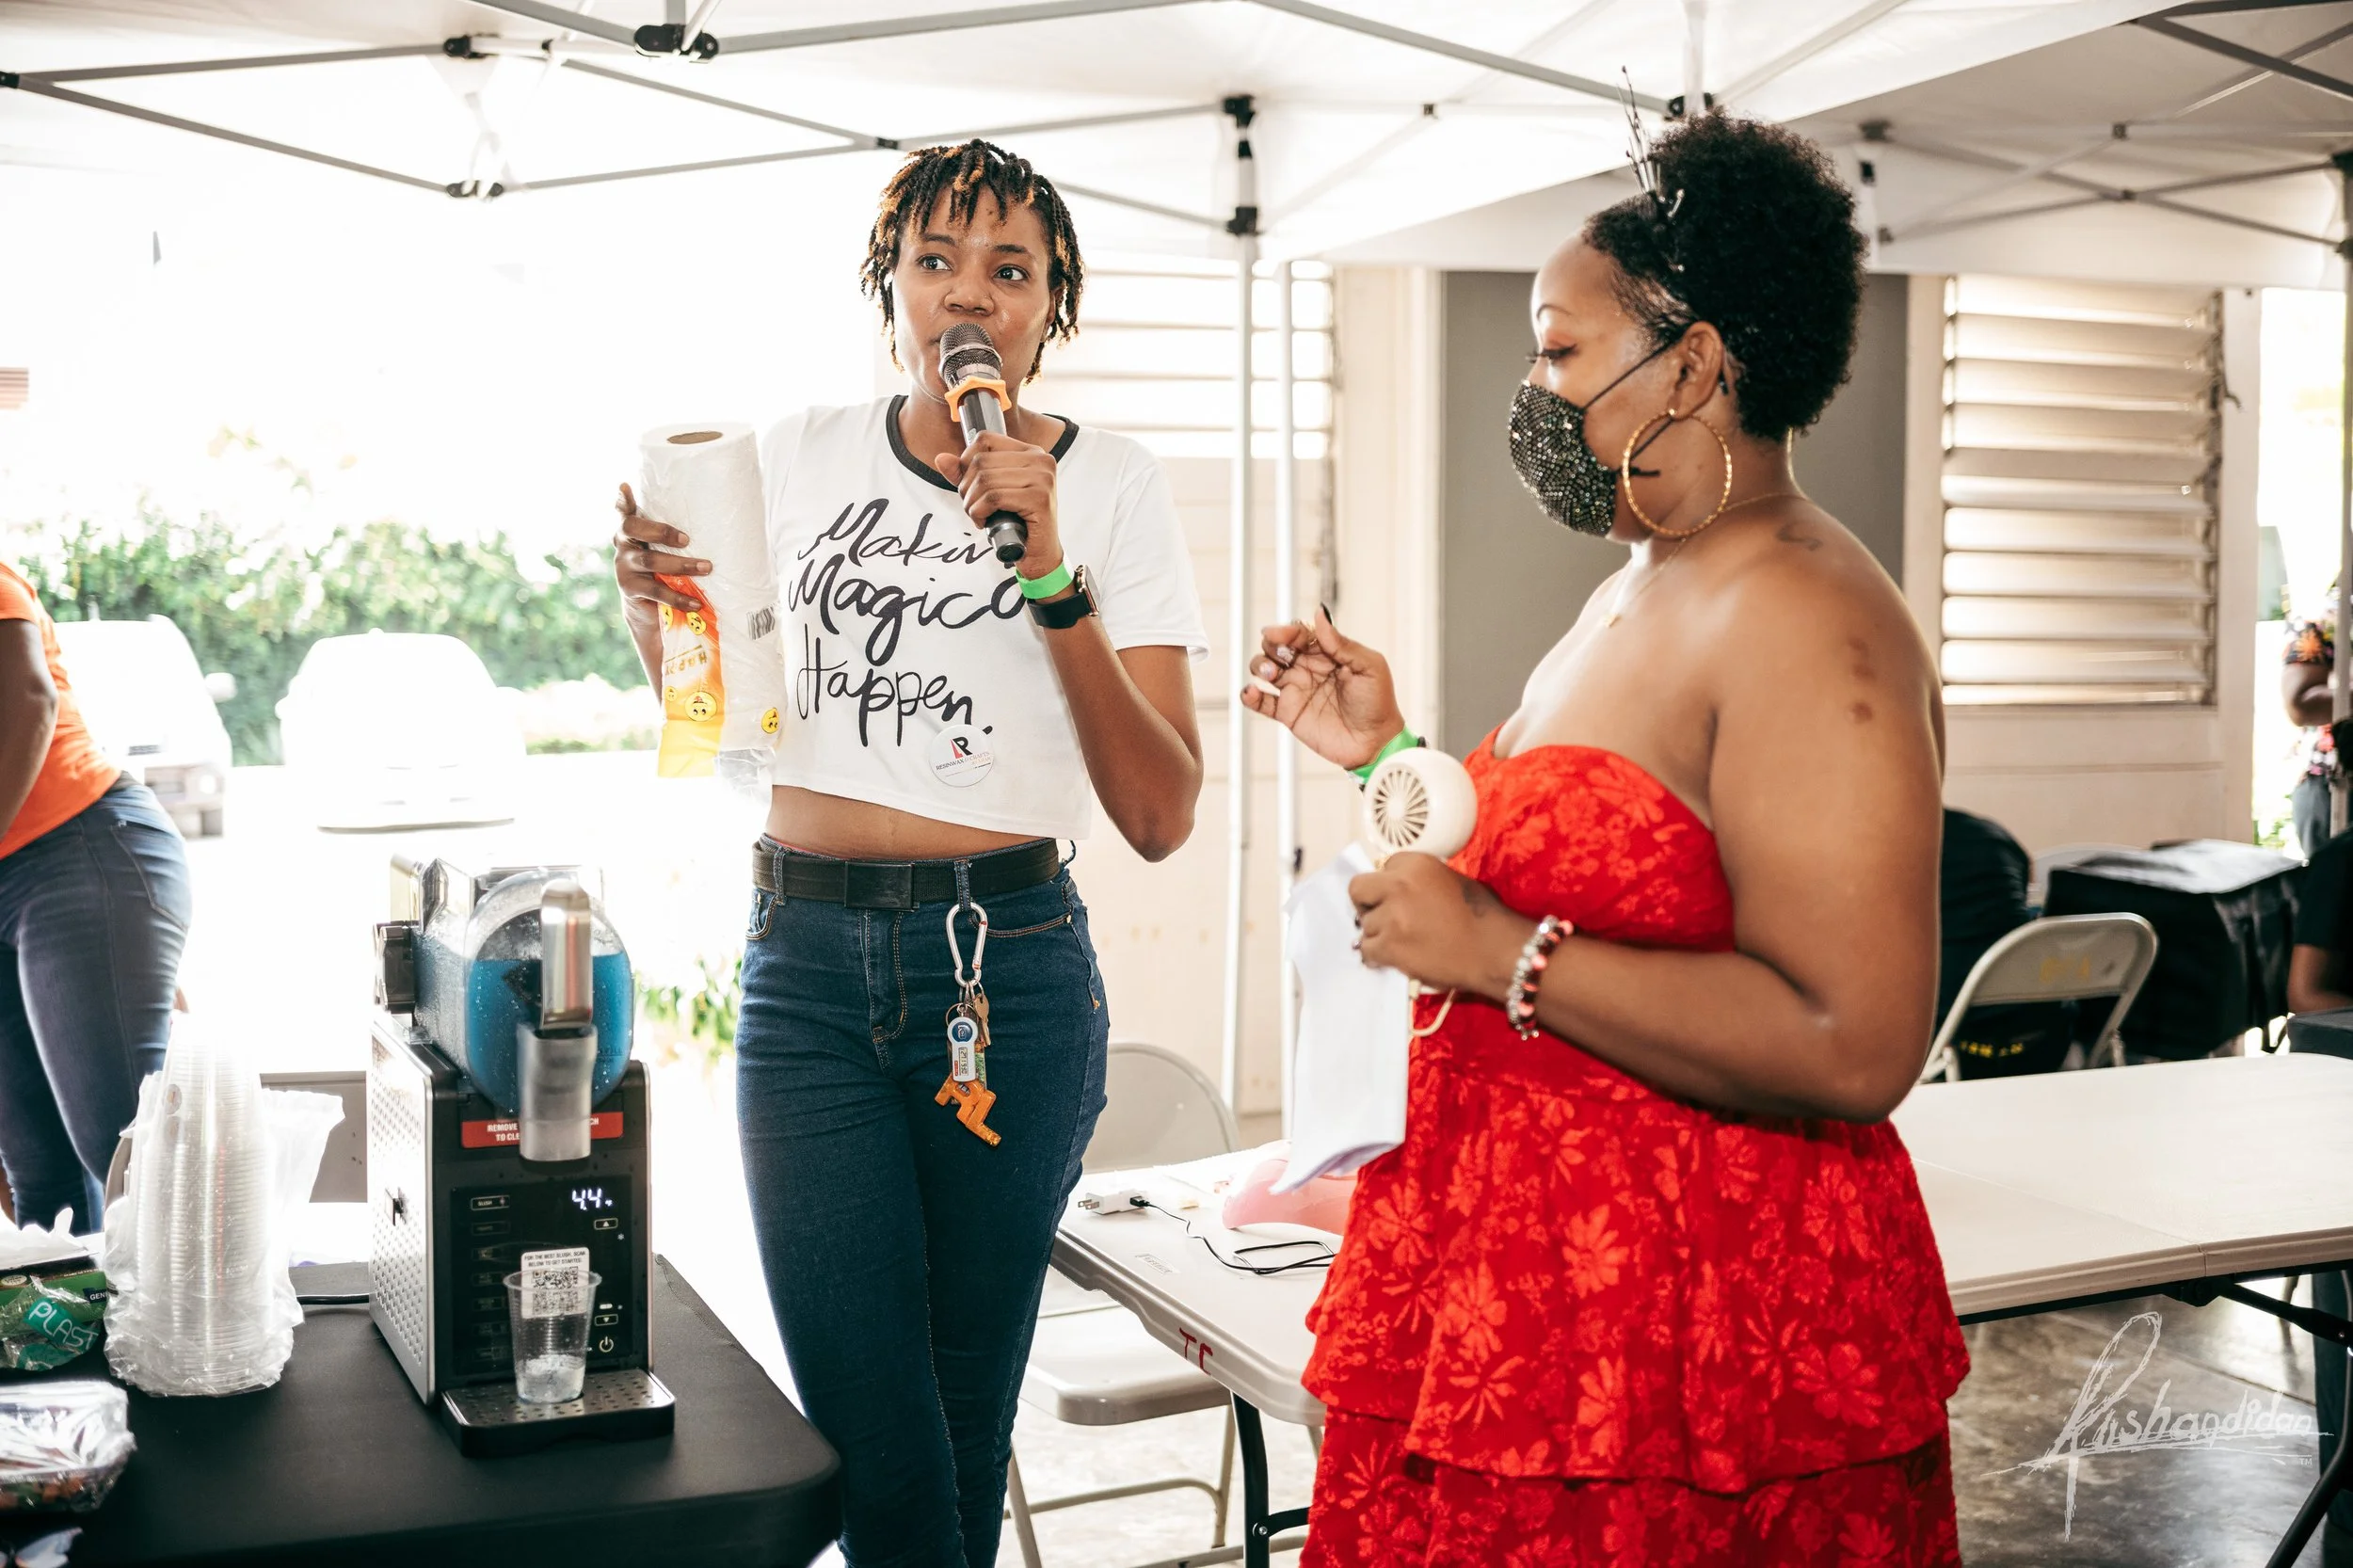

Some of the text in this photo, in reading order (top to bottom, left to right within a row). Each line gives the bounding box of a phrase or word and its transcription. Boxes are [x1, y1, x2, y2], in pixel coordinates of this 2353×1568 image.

[798, 498, 1015, 569] Makin
[487, 1123, 518, 1131] REMOVE
[495, 1133, 506, 1142] TO
